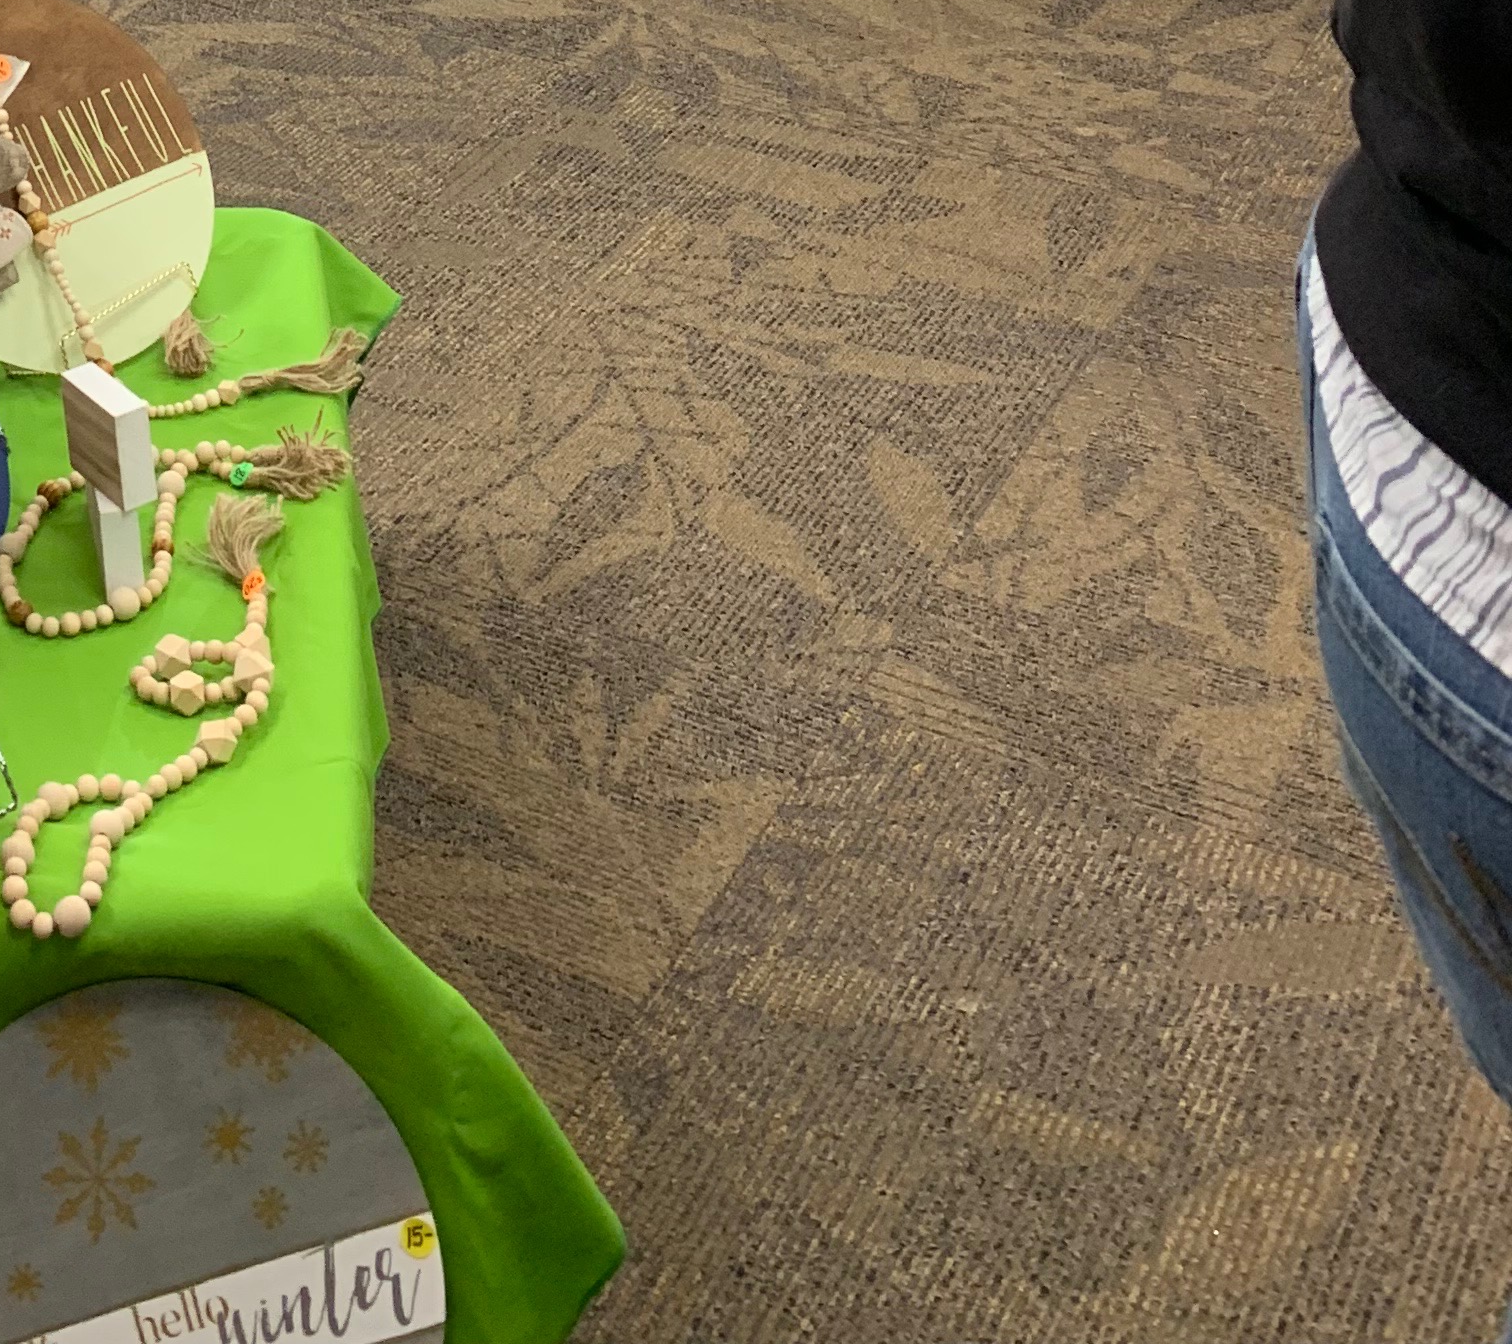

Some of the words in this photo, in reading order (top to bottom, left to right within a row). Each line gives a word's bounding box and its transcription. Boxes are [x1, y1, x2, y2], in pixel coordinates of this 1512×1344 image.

[14, 72, 193, 211] HANKFUL
[131, 1285, 231, 1344] hello
[216, 1240, 422, 1344] winter
